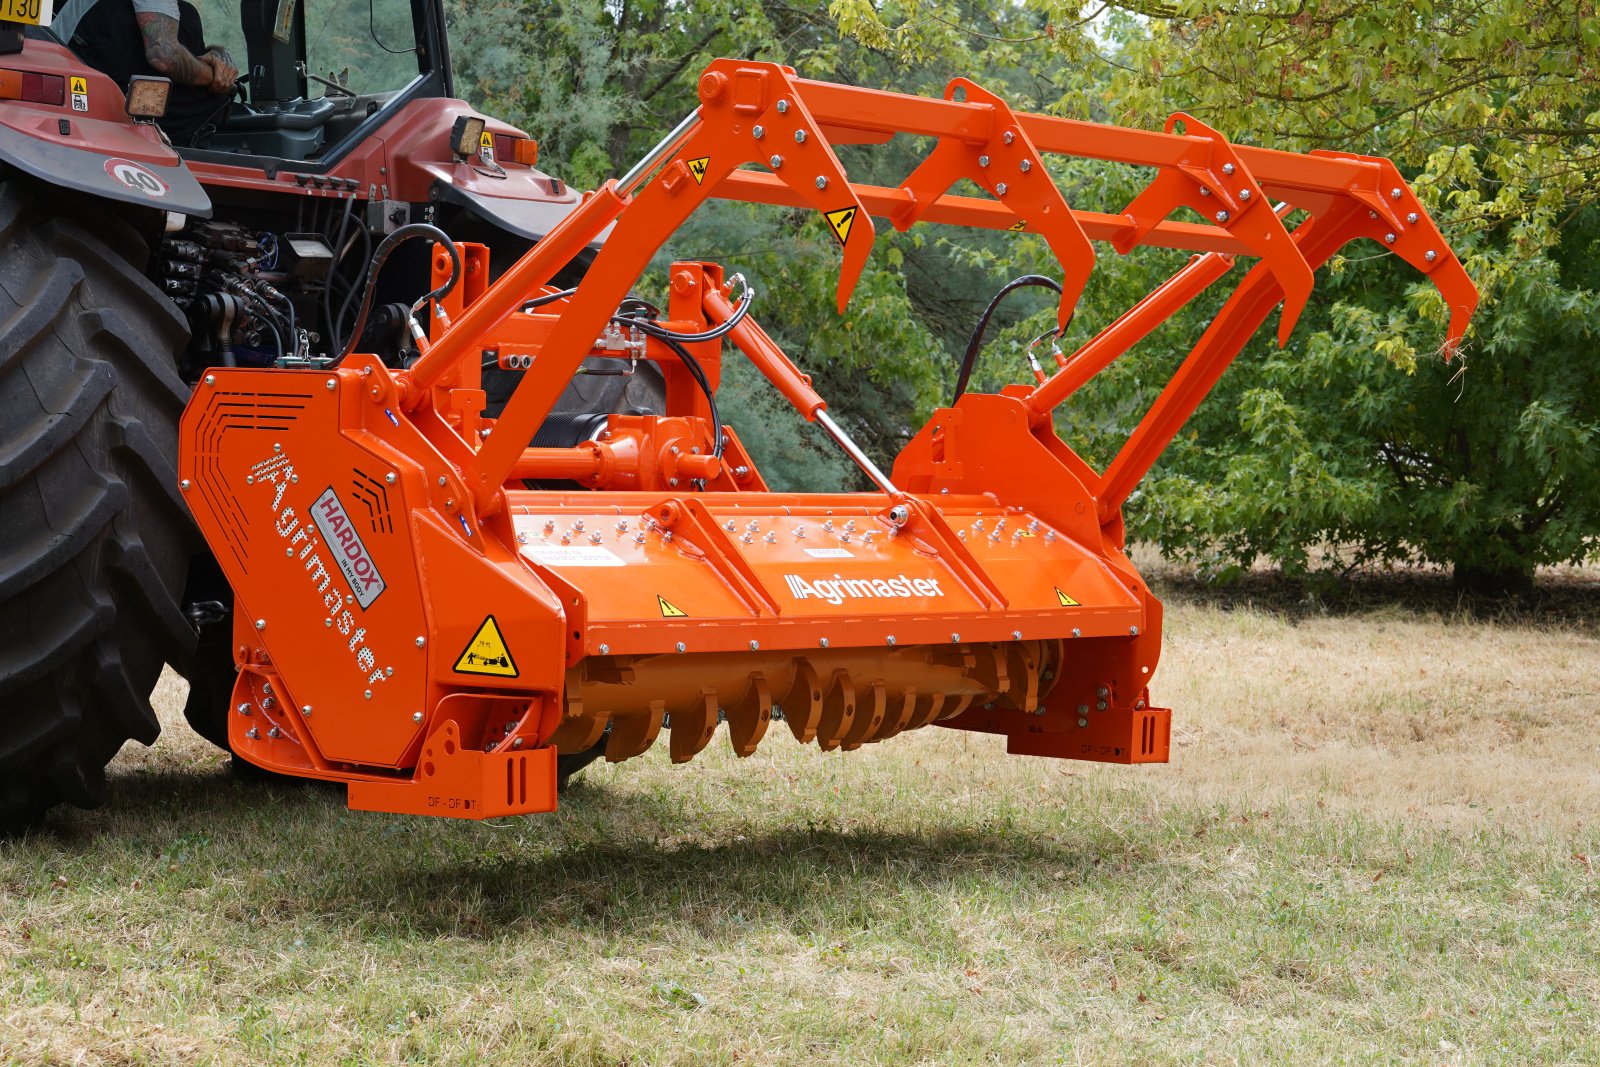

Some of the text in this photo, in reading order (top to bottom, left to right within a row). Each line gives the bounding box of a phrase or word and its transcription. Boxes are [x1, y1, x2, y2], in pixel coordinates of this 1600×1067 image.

[0, 0, 40, 19] 130
[122, 169, 161, 192] 40
[319, 496, 380, 591] HARDOX
[250, 452, 387, 685] Agrimaster
[342, 559, 364, 597] IN MY BODY
[783, 573, 945, 605] Agrimaster
